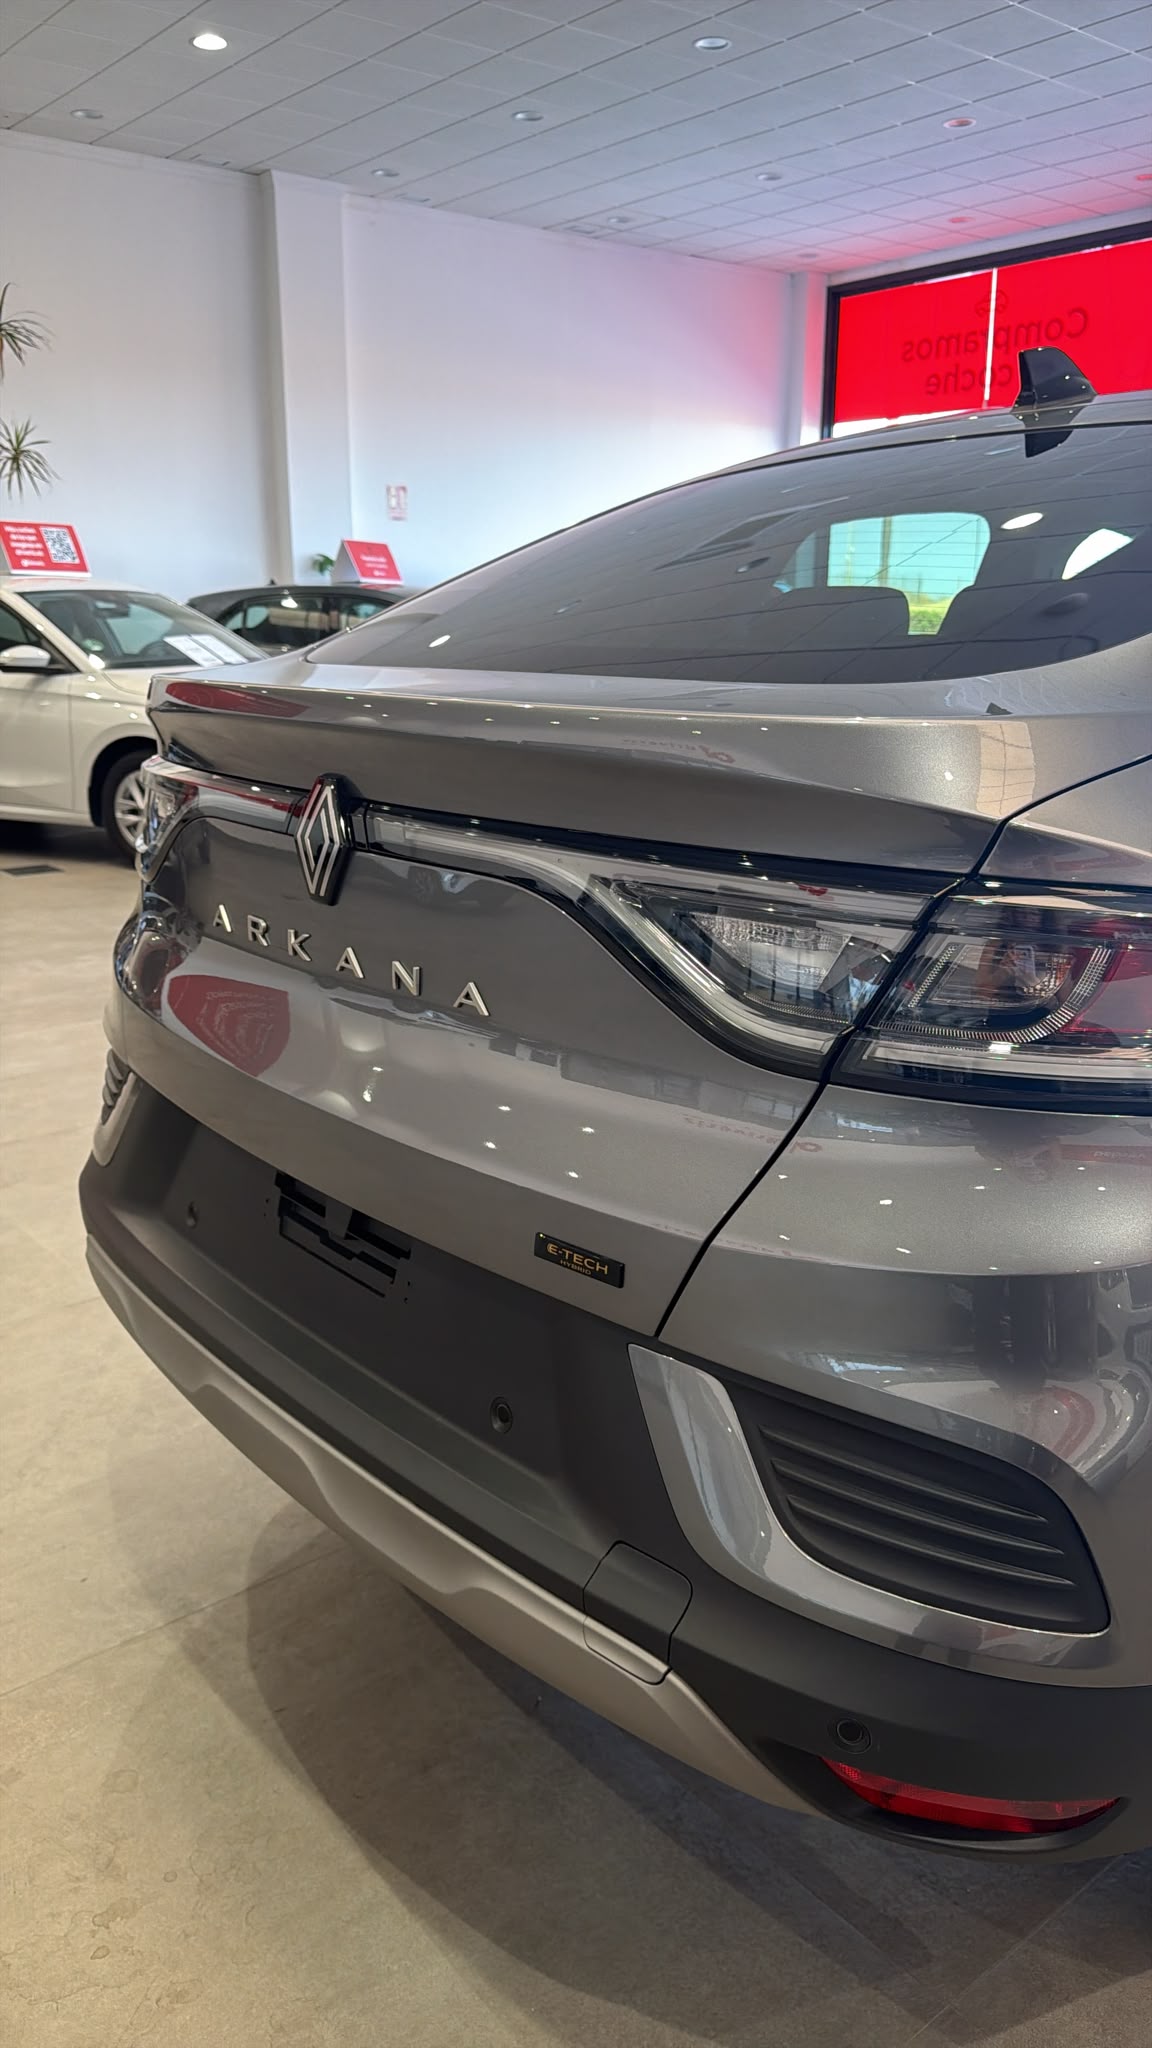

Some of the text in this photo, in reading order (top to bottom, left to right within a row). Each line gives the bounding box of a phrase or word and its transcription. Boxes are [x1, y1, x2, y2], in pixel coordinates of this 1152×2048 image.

[213, 904, 490, 1017] ARKANA
[546, 1242, 609, 1275] E-TECH
[560, 1259, 592, 1275] HYBRID
